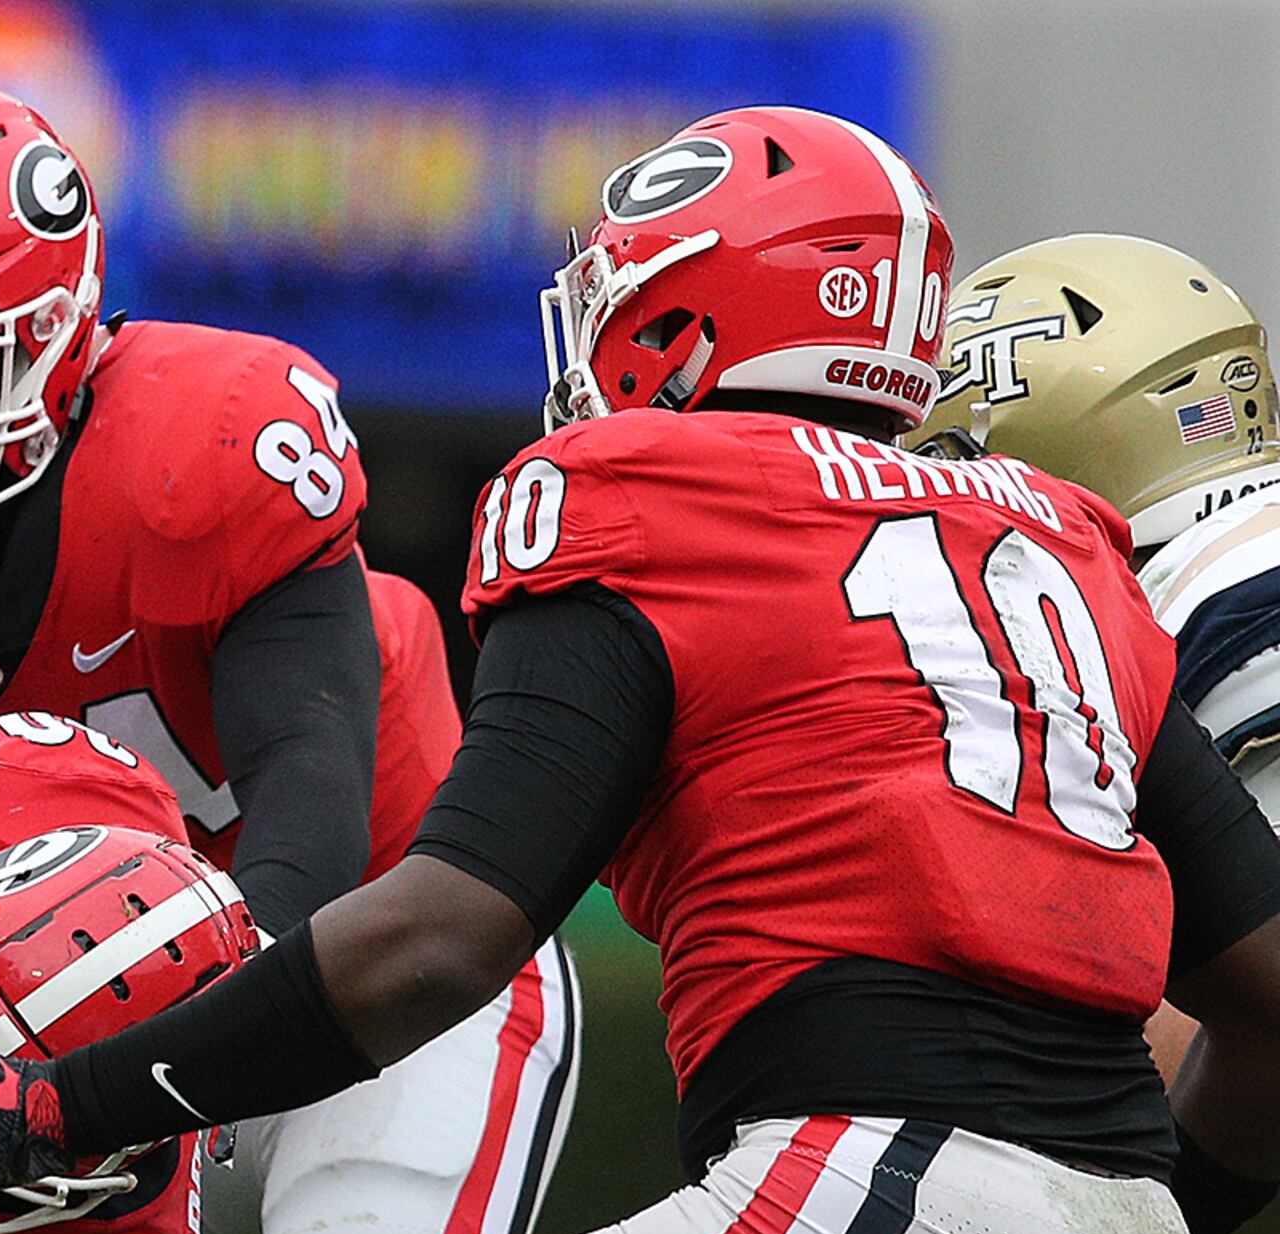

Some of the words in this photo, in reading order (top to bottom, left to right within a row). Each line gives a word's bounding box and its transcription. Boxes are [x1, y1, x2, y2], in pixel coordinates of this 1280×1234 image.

[826, 272, 862, 311] SEC
[253, 364, 358, 520] 84
[826, 358, 932, 409] GEORGIA
[482, 457, 568, 586] 10
[839, 511, 1139, 852] 10
